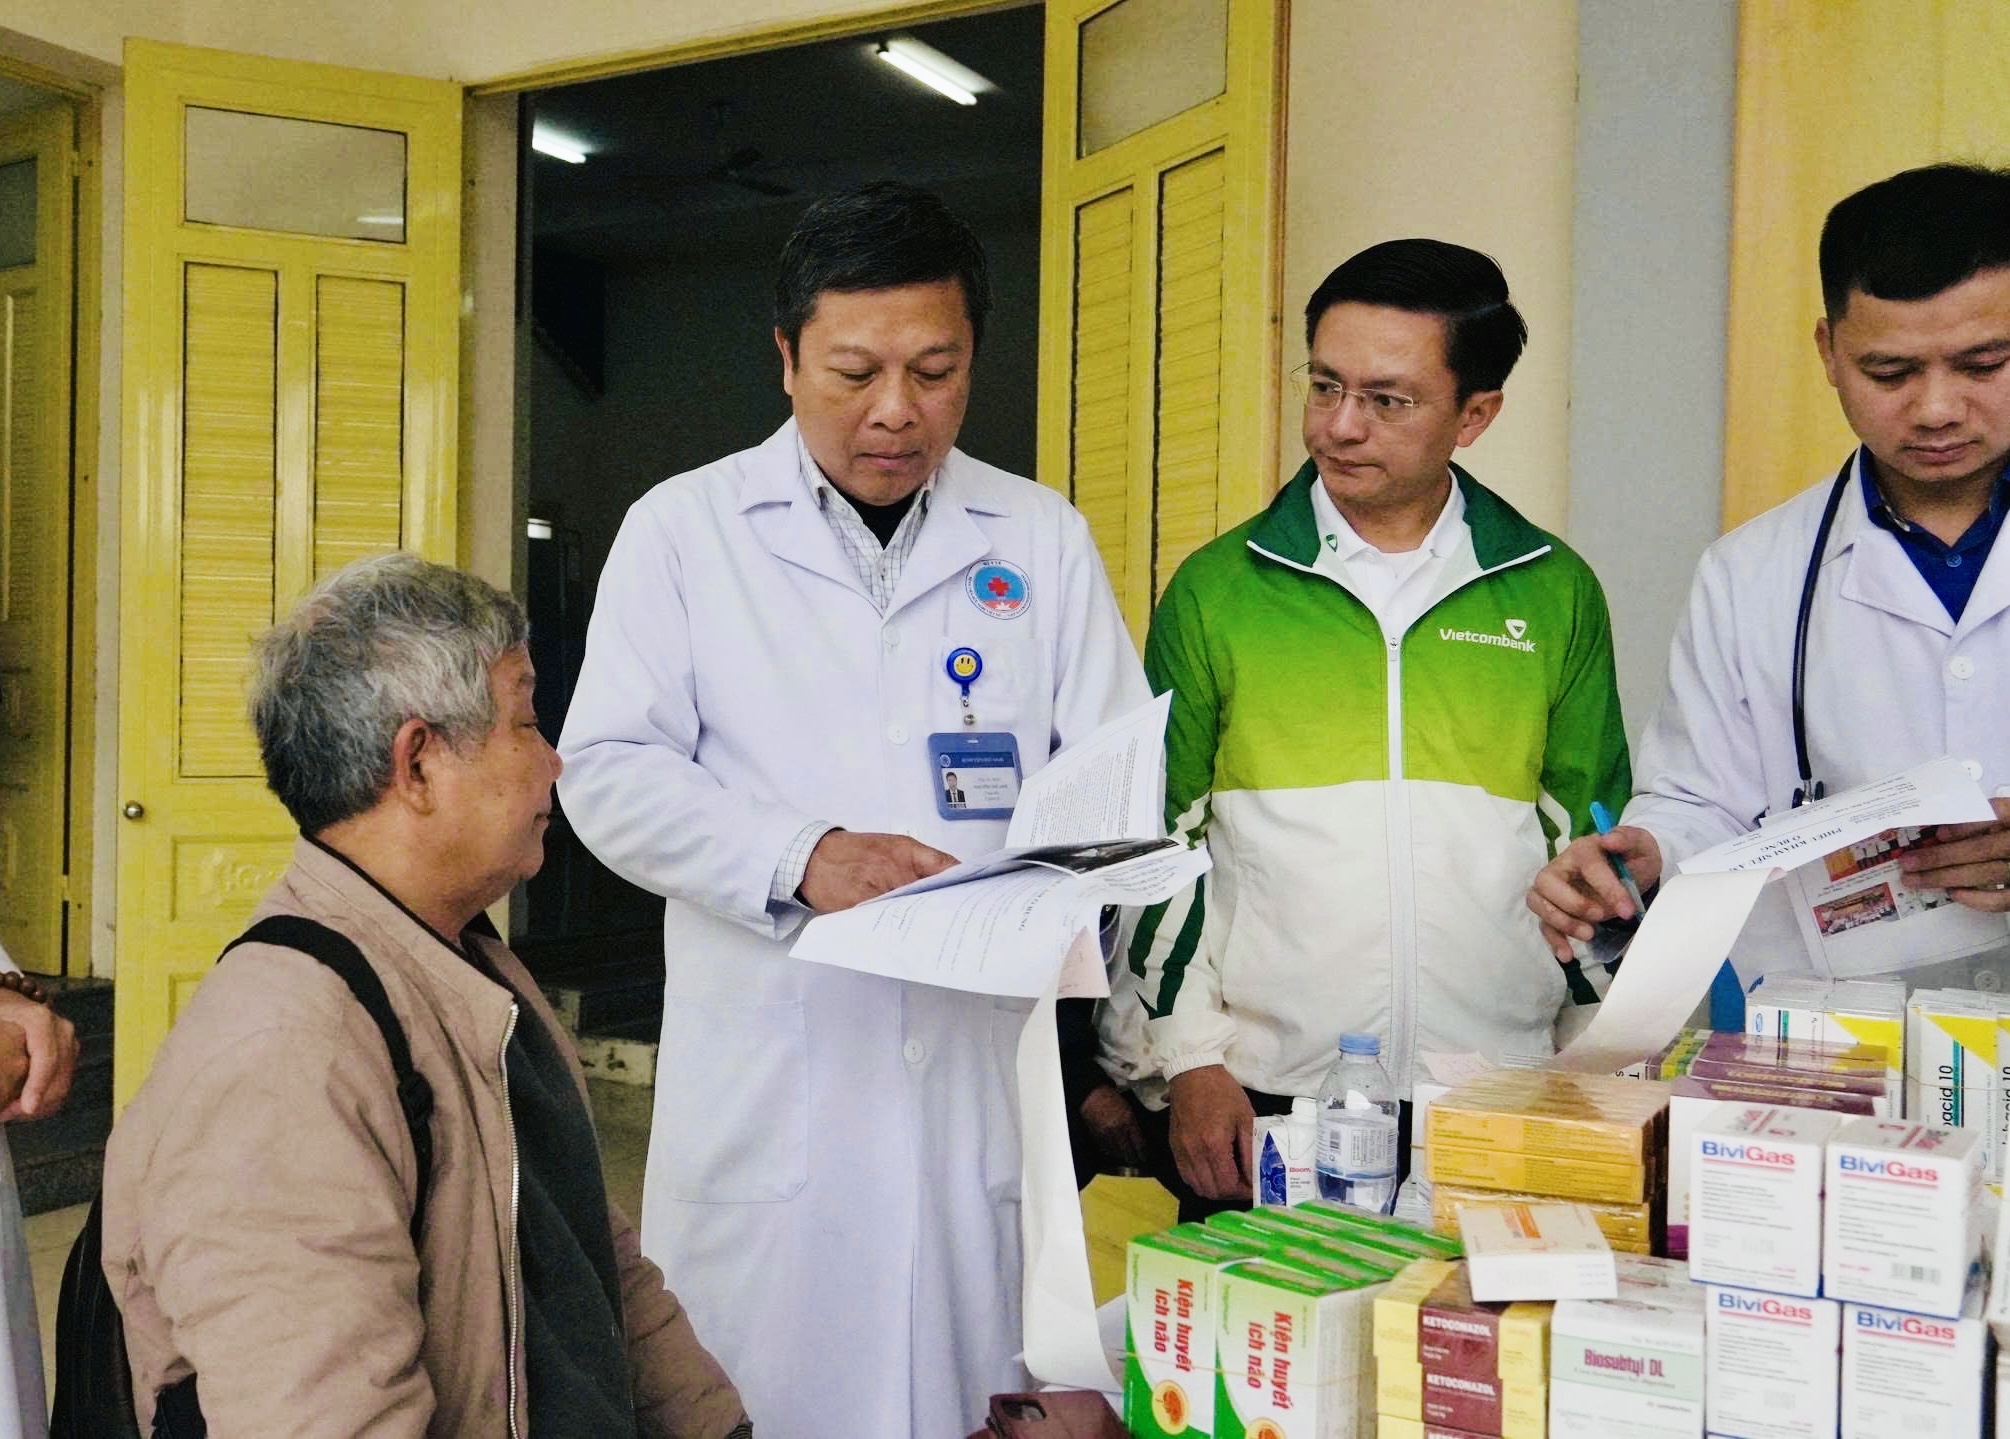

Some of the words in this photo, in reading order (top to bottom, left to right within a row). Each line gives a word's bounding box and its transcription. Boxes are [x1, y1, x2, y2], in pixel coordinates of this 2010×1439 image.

[1439, 628, 1536, 653] Vietcombank
[1939, 1065, 1953, 1081] 10
[1702, 1141, 1795, 1165] BiviGas
[1840, 1155, 1938, 1181] BiviGas
[1173, 1278, 1194, 1320] Kiện
[1719, 1293, 1812, 1319] BiviGas
[1270, 1311, 1292, 1354] Kiện
[1422, 1315, 1492, 1337] KETOCONAZOL
[1857, 1311, 1955, 1339] BiviGas
[1584, 1348, 1645, 1377] Biosubtyl
[1649, 1358, 1665, 1378] DL
[1426, 1373, 1497, 1396] KETOCONAZOL
